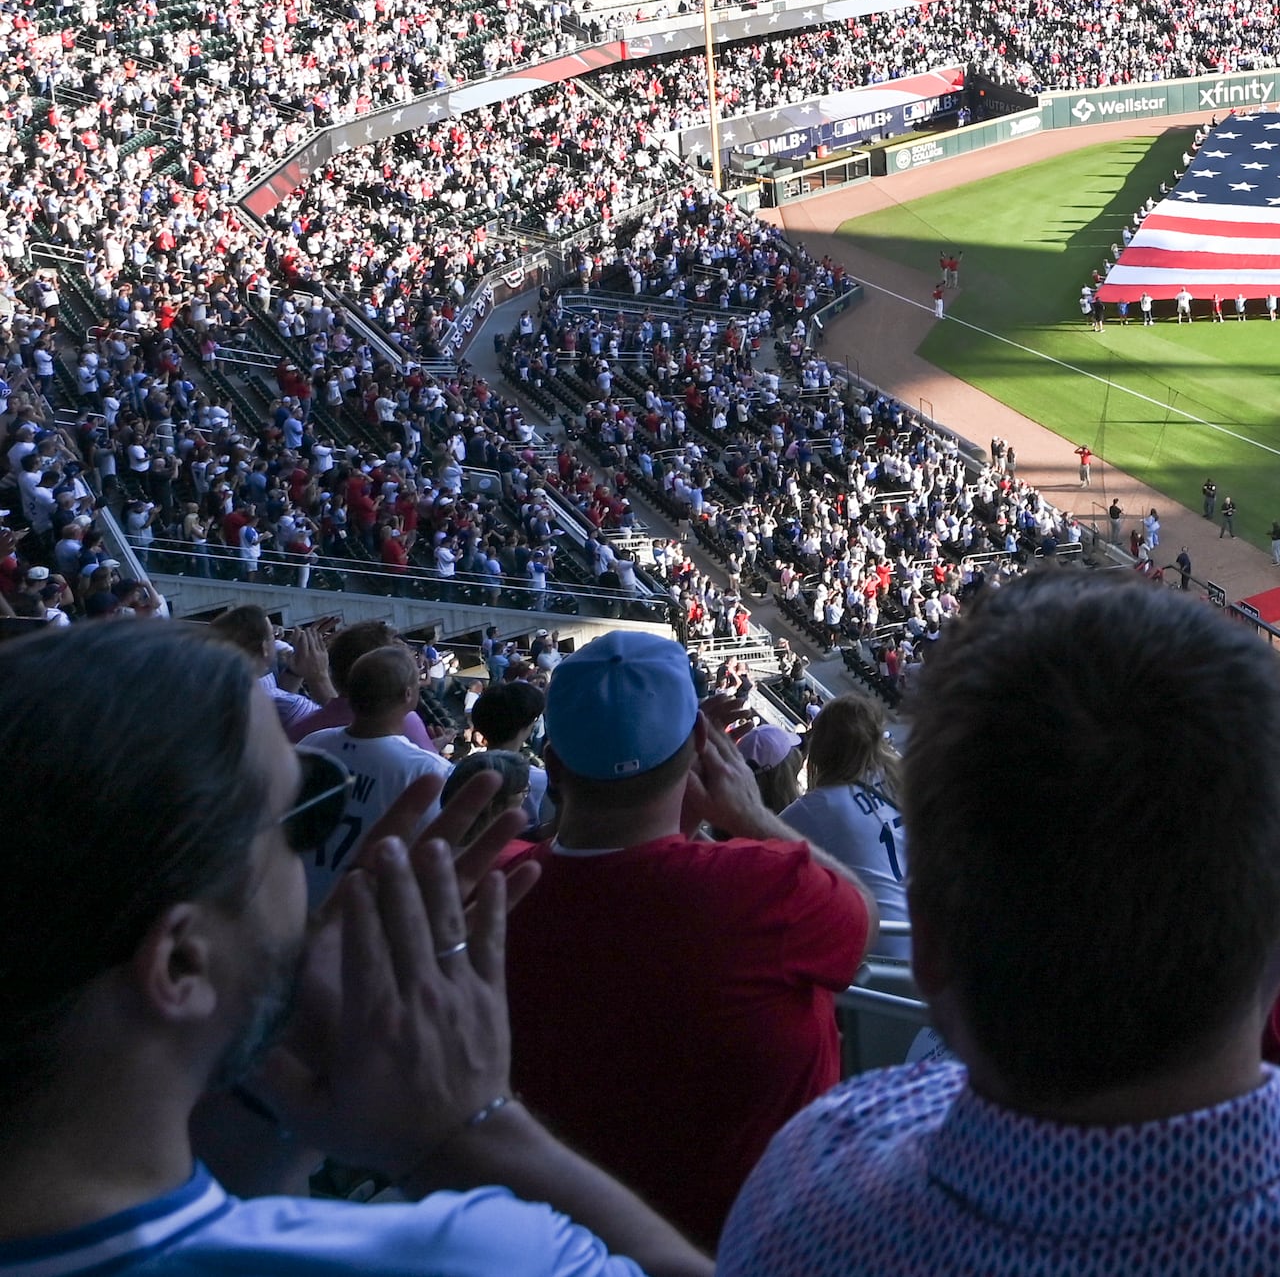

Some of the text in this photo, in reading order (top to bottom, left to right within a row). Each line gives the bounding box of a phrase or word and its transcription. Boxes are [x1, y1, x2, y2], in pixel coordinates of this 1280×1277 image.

[1200, 78, 1275, 109] xfinity
[1098, 96, 1166, 116] Wellstar
[856, 111, 893, 133] MLB+
[769, 132, 808, 156] MLB+
[912, 141, 937, 156] SOUTH
[912, 147, 944, 163] COLLEGE
